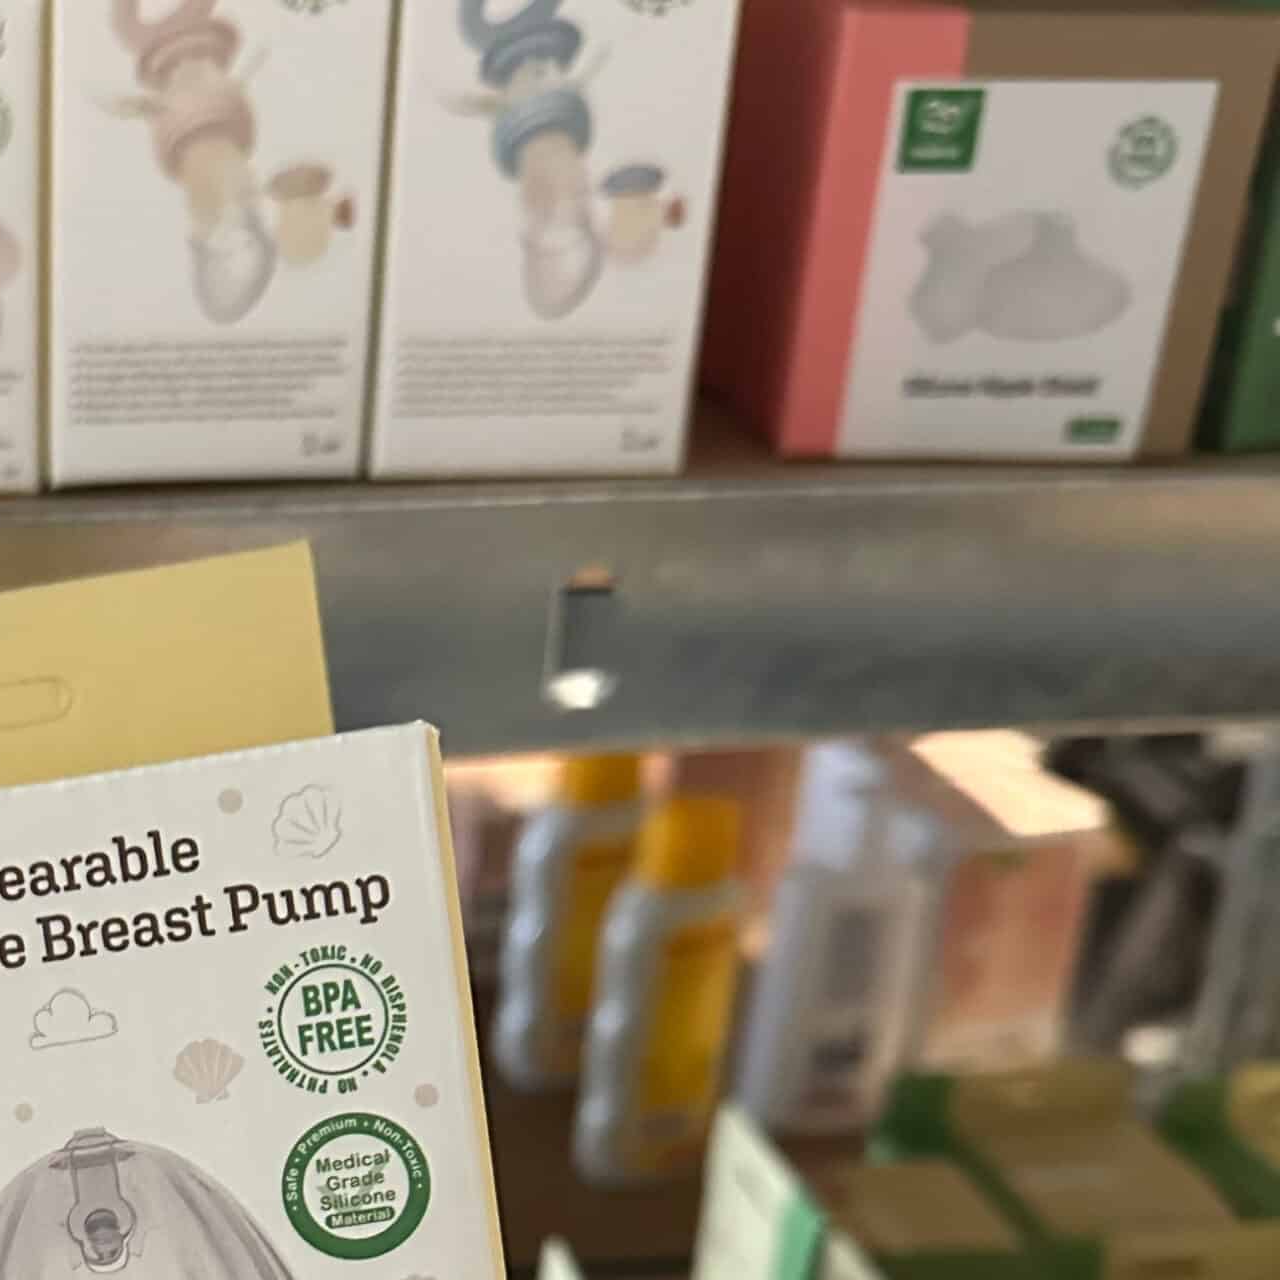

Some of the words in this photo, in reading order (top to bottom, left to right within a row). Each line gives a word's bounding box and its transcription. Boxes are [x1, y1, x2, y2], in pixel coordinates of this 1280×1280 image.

[36, 894, 216, 963] Breast
[223, 872, 391, 933] Pump
[359, 953, 383, 975] NO
[301, 978, 361, 1017] BPA
[297, 1014, 375, 1057] FREE
[337, 1077, 358, 1094] NO
[286, 1167, 299, 1201] Safe
[296, 1117, 358, 1155] Premium
[373, 1119, 423, 1178] Non-Toxic
[315, 1148, 391, 1174] Medical
[325, 1170, 385, 1192] Grade
[320, 1189, 396, 1211] Silicone
[330, 1208, 391, 1228] Material
